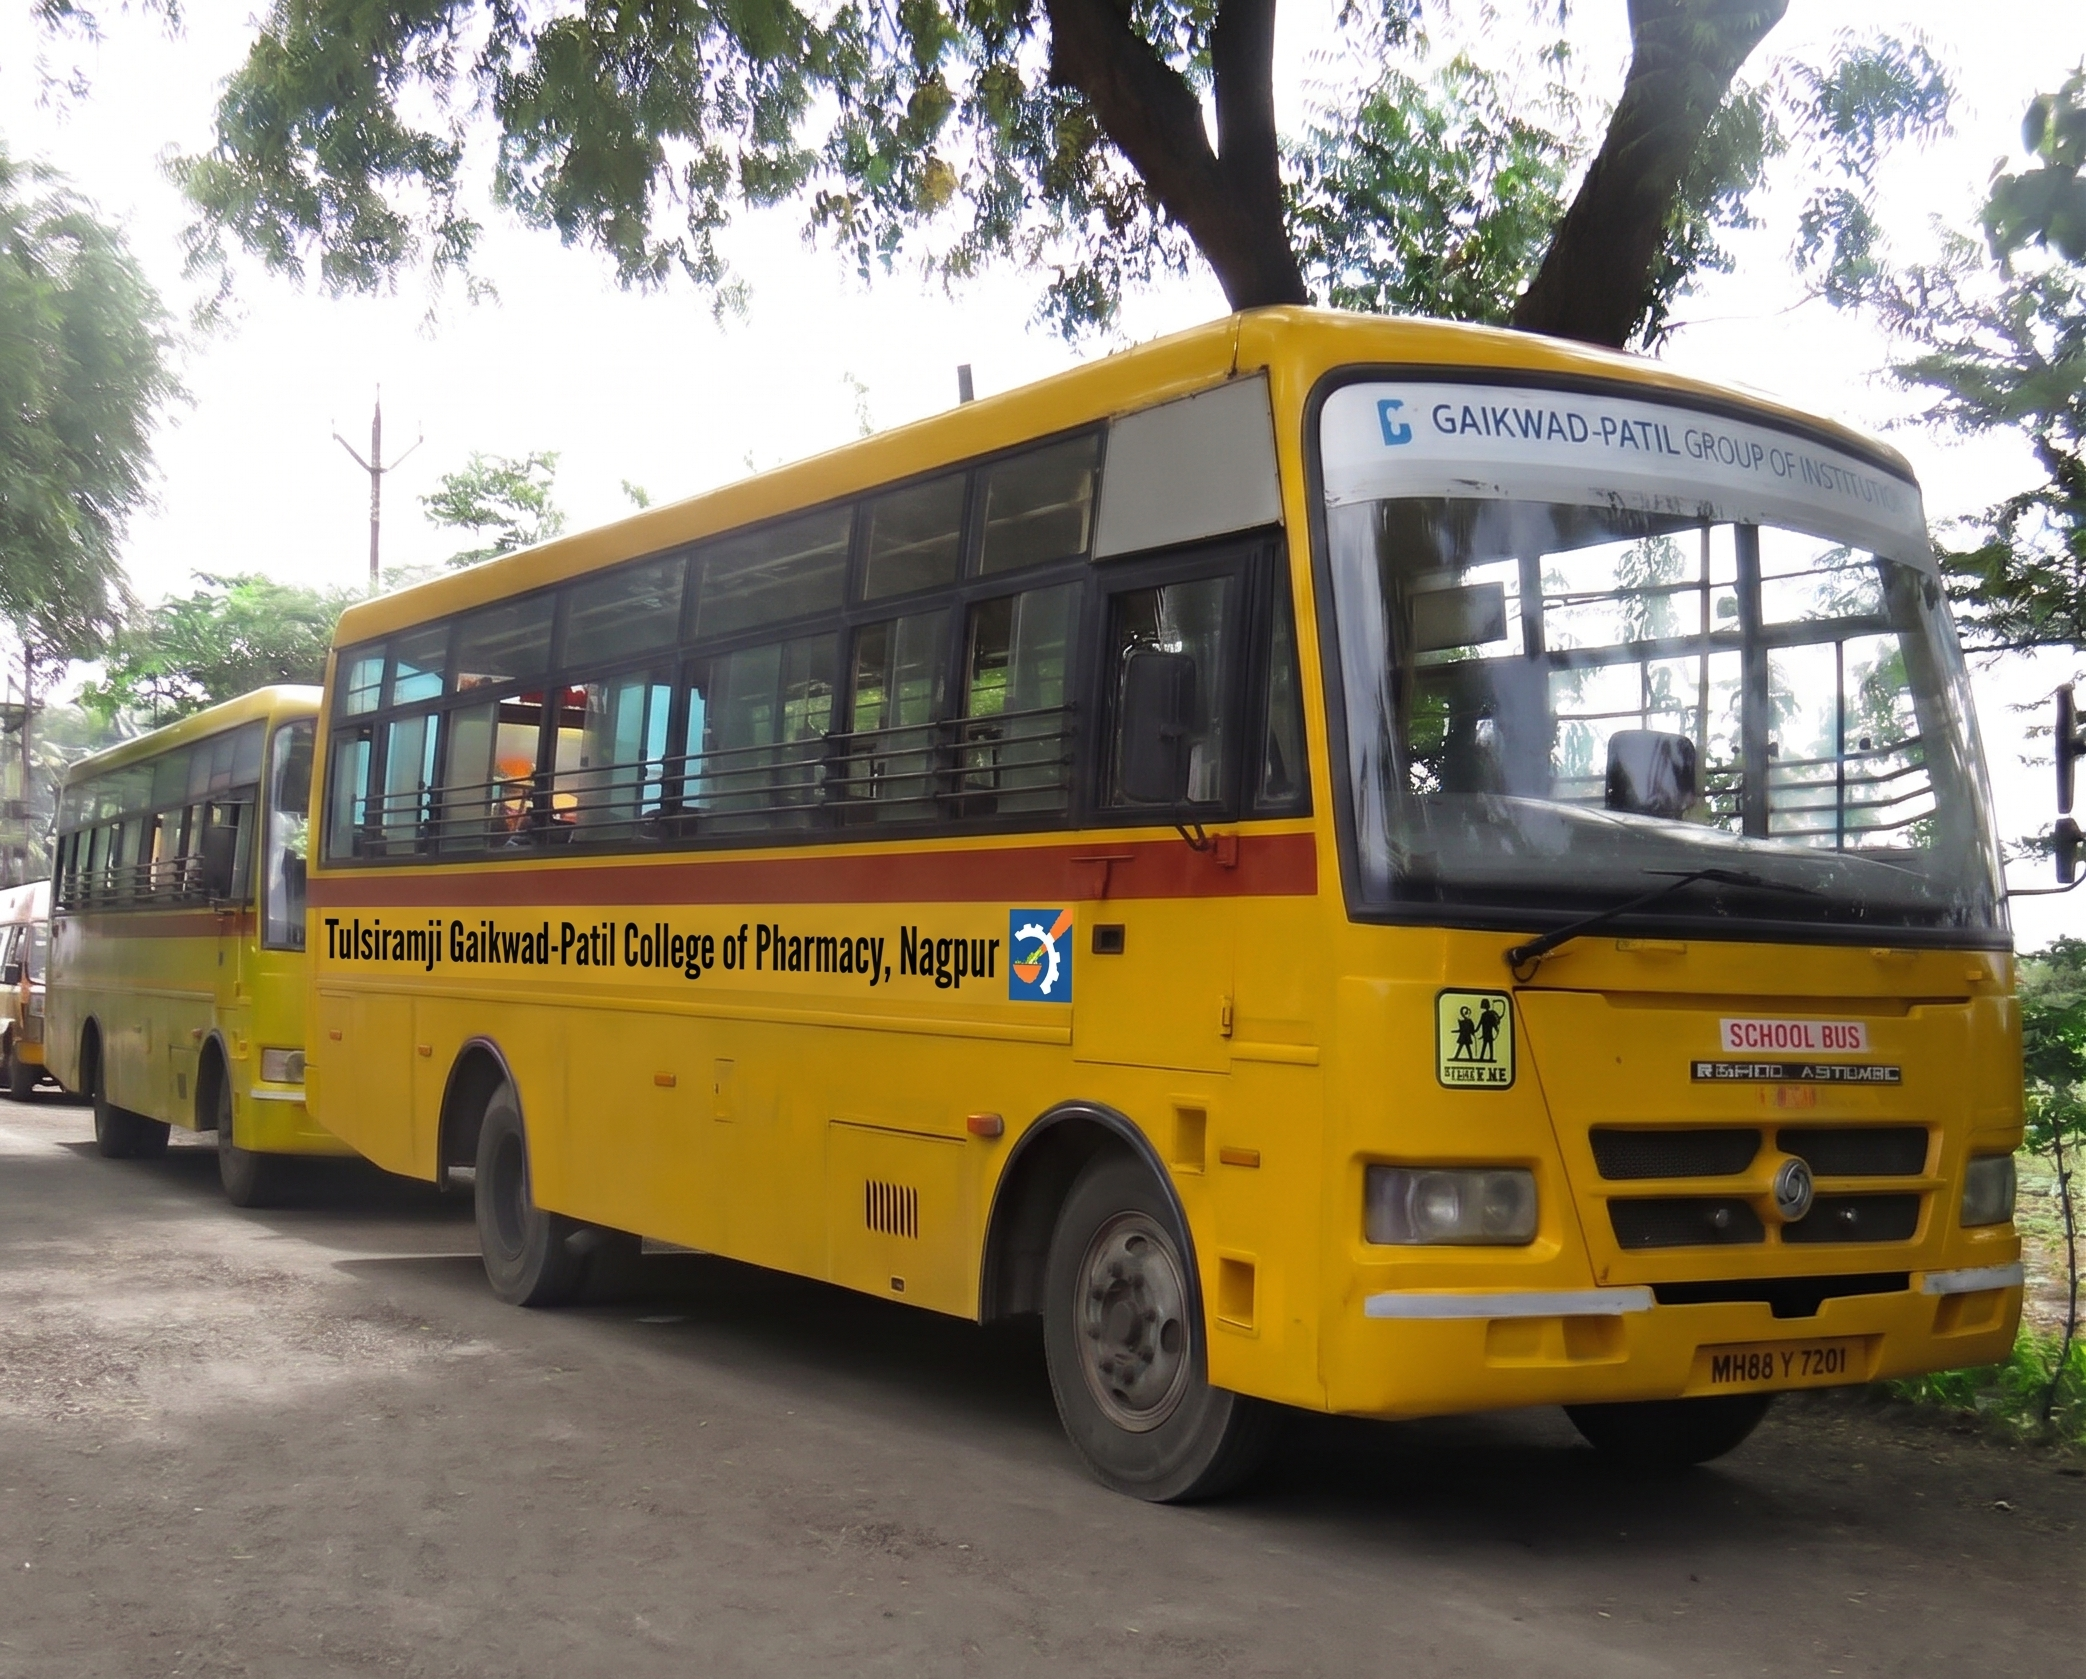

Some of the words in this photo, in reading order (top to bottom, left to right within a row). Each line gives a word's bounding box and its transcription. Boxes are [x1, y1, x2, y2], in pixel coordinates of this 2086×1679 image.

[1431, 403, 1682, 455] GAIKWAD-PATIL
[1684, 428, 1764, 472] GROUP
[1769, 447, 1796, 479] OF
[324, 918, 443, 972] Tulsiramji
[449, 919, 616, 967] Gaikwad-Patil
[623, 921, 715, 980] College
[722, 923, 749, 971] of
[755, 923, 892, 987] Pharmacy,
[899, 925, 1000, 989] Nagpur
[1729, 1022, 1815, 1049] SCHOOL
[1821, 1025, 1861, 1049] BUS
[1711, 1352, 1774, 1384] MH88
[1780, 1351, 1795, 1378] Y
[1801, 1347, 1846, 1377] 7201
